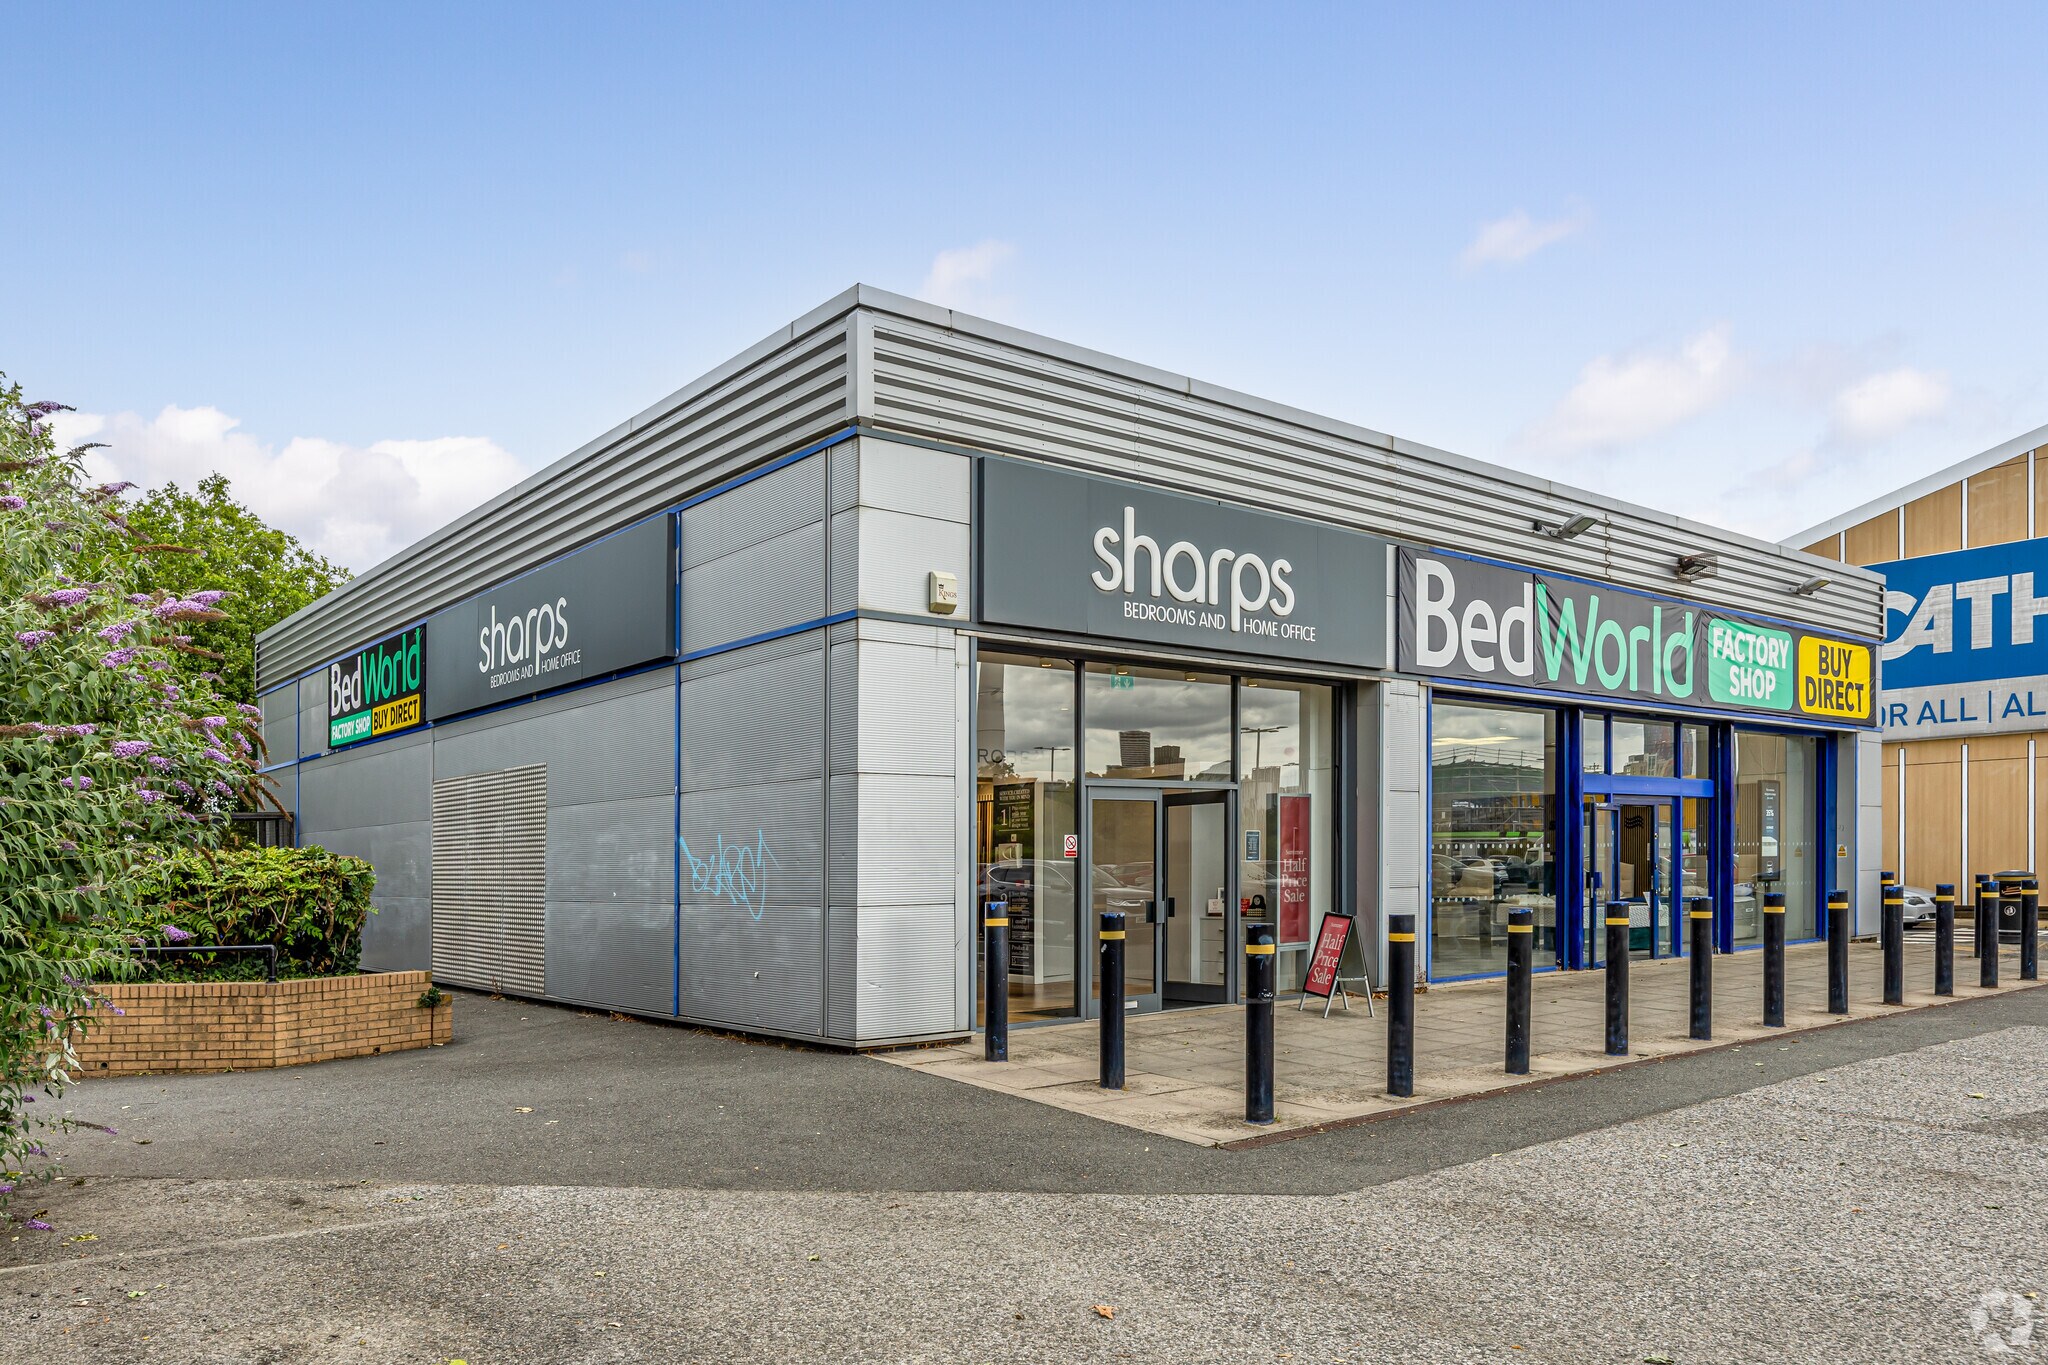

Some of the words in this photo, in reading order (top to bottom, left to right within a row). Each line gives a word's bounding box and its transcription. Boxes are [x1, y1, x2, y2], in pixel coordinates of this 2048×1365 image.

[1091, 506, 1295, 632] sharps
[479, 596, 568, 676] sharps
[1123, 601, 1196, 626] BEDROOMS
[1199, 612, 1226, 630] AND
[1243, 617, 1279, 637] HOME
[1281, 623, 1316, 642] OFFICE
[1712, 627, 1790, 669] FACTORY
[1818, 644, 1853, 679] BUY
[490, 668, 520, 689] BEDROOMS
[520, 664, 534, 680] AND
[541, 655, 560, 674] HOME
[560, 649, 581, 668] OFFICE
[1729, 665, 1776, 700] SHOP
[1805, 676, 1864, 713] DIRECT
[1882, 703, 1908, 728] R
[1916, 697, 1978, 725] ALL
[2001, 691, 2046, 718] AL
[331, 719, 356, 741] FACTORY
[355, 715, 371, 733] SHOP
[373, 708, 389, 731] BUY
[390, 699, 418, 726] DIRECT
[1281, 873, 1308, 888] Price
[1283, 857, 1307, 872] Half
[1283, 889, 1305, 903] Sale
[1313, 949, 1339, 968] Price
[1321, 933, 1346, 951] Half
[1311, 967, 1332, 985] Sale
